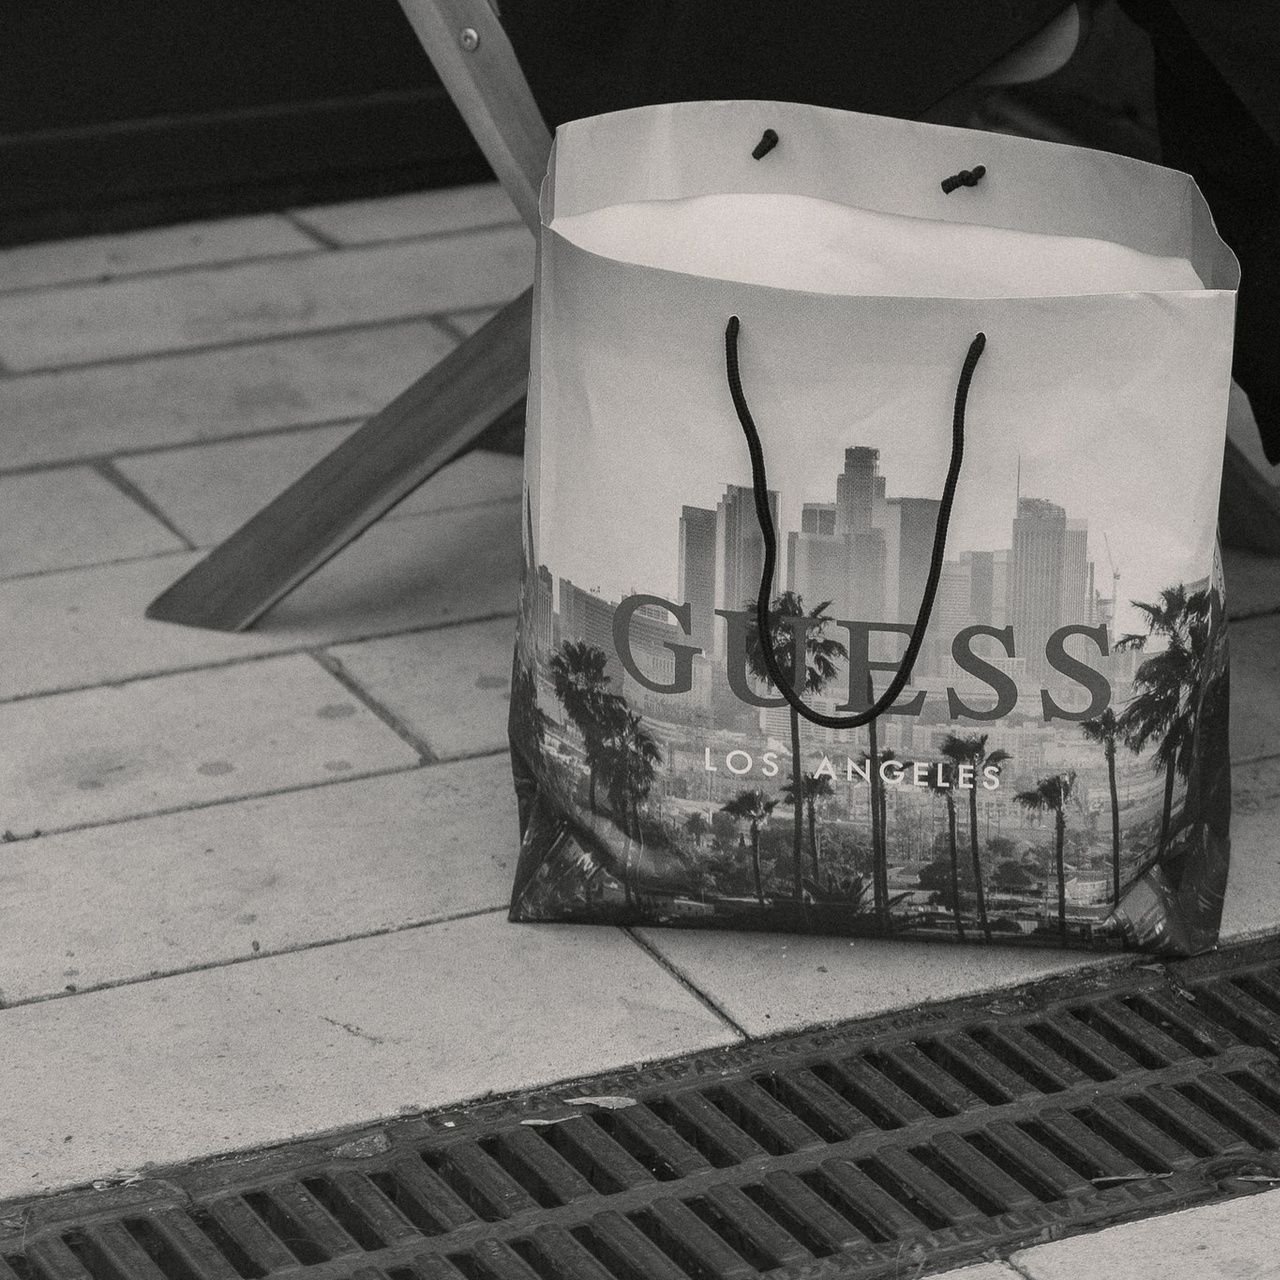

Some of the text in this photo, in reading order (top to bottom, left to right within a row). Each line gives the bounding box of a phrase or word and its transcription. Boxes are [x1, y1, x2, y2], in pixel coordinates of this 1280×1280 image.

[612, 594, 1111, 722] GUESS
[705, 748, 1001, 790] LOS ANGELES
